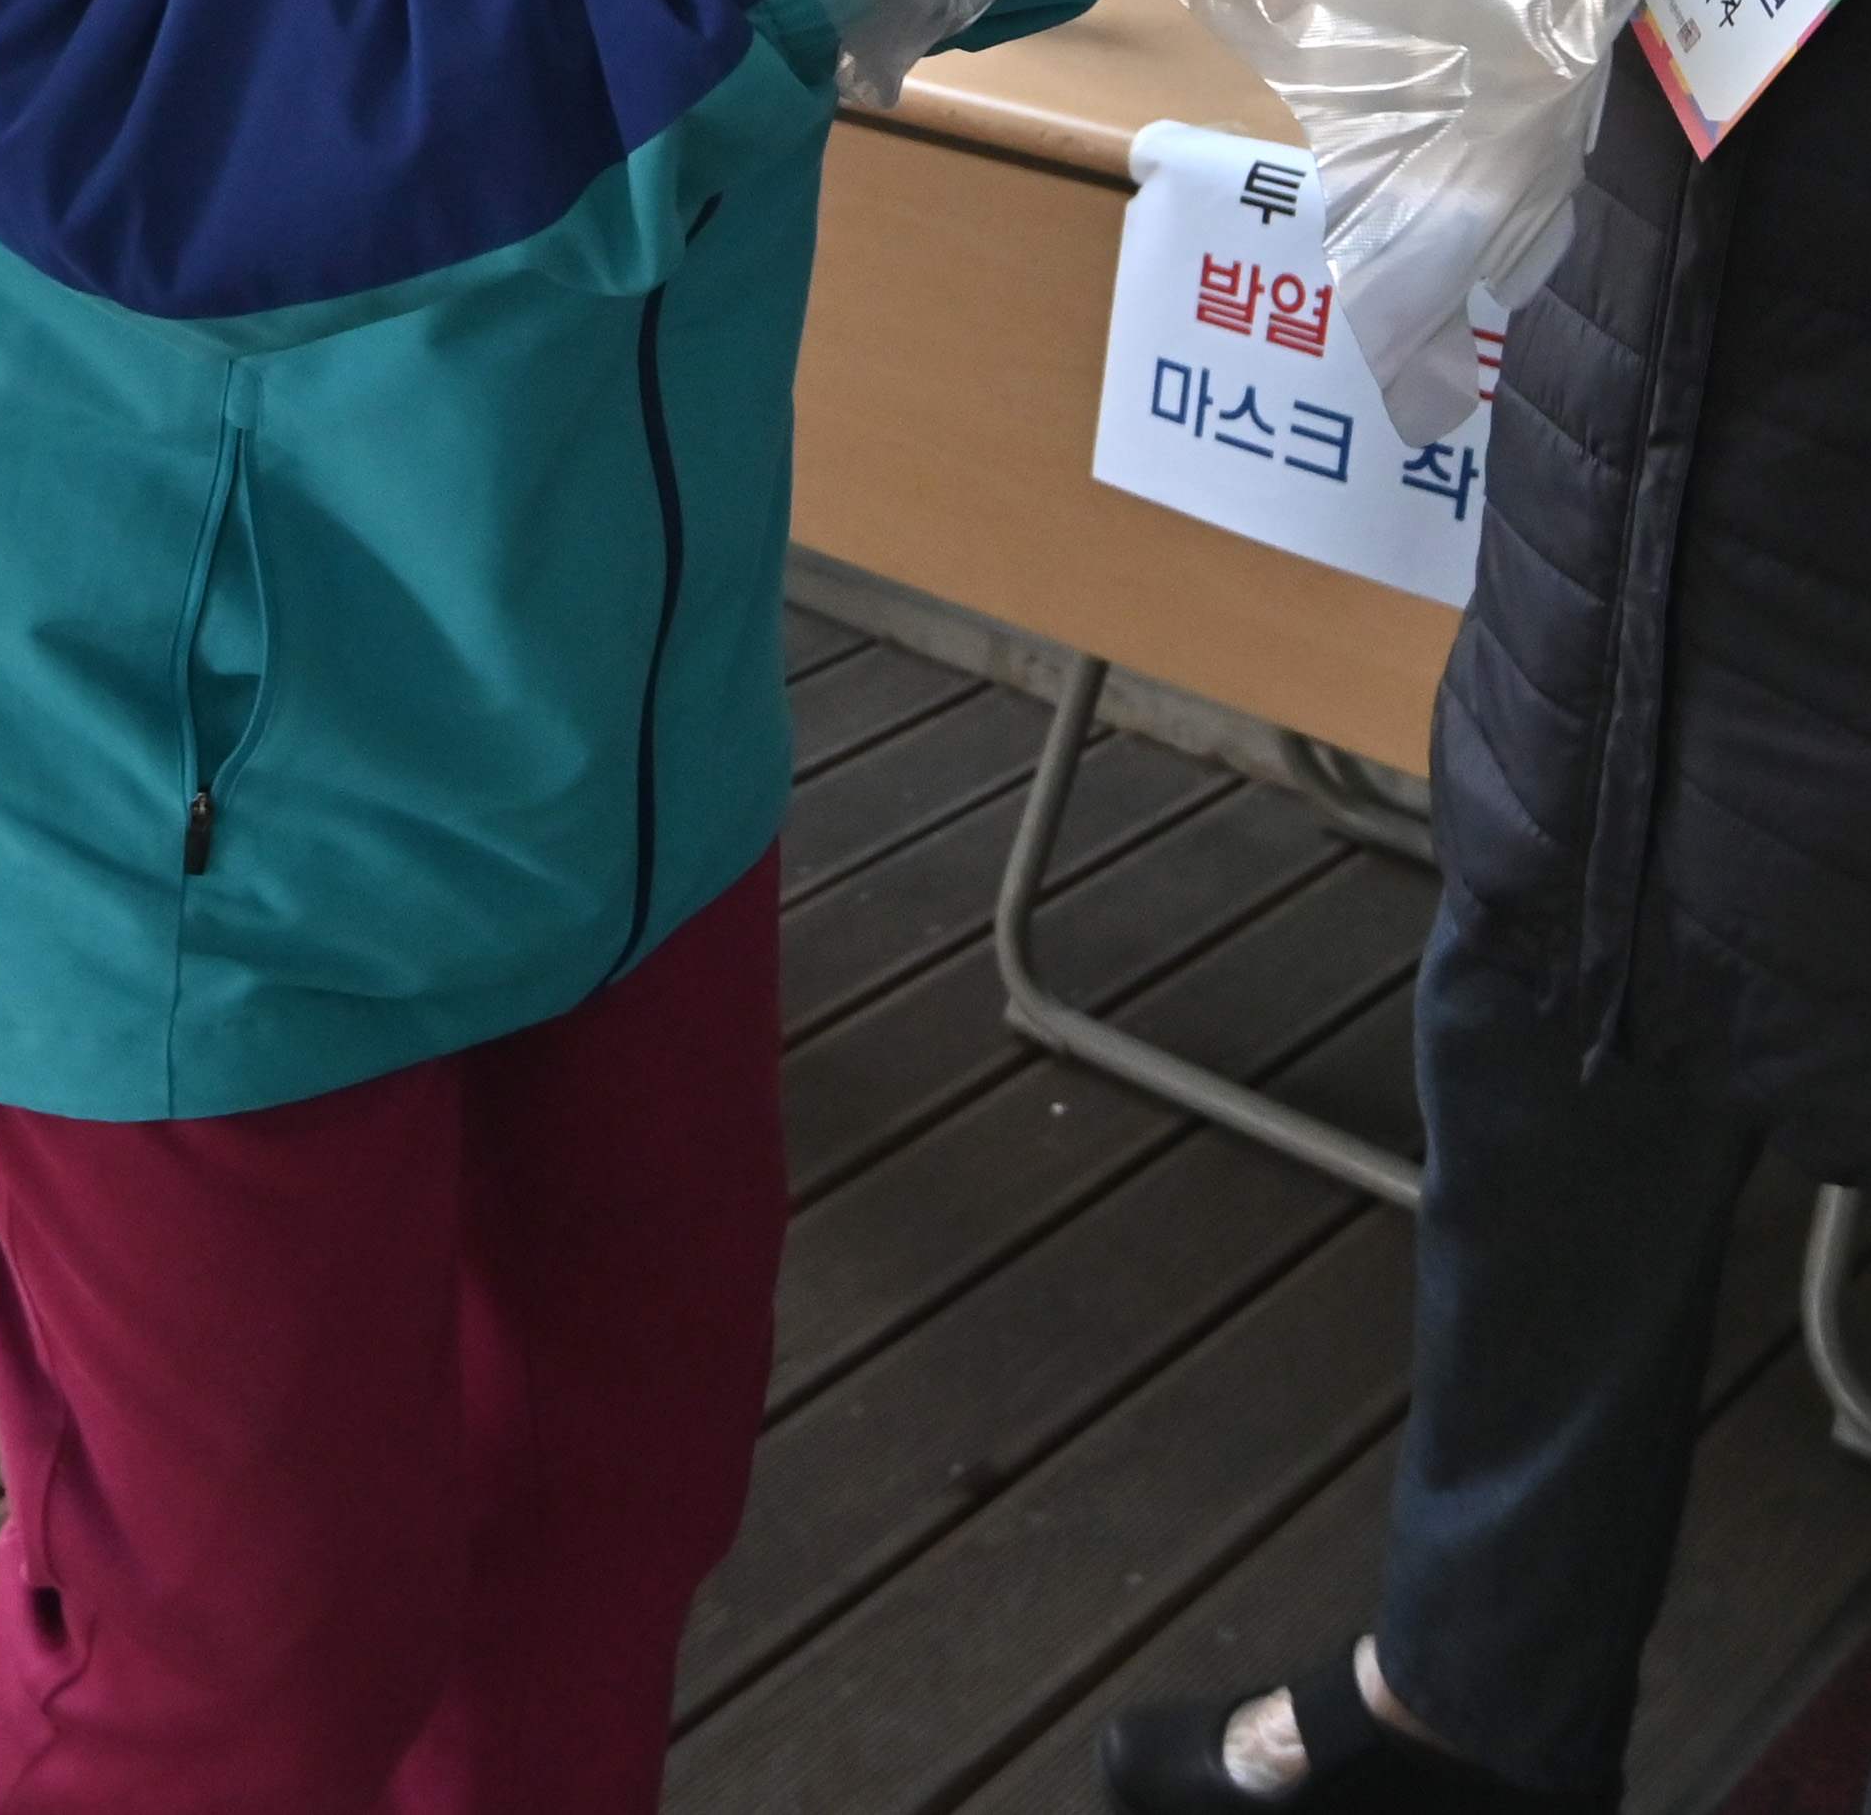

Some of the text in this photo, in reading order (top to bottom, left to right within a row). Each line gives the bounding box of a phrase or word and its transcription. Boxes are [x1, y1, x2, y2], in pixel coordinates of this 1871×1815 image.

[1196, 251, 1334, 359] 발열
[1151, 356, 1354, 484] 마스크
[1401, 440, 1480, 520] 착
